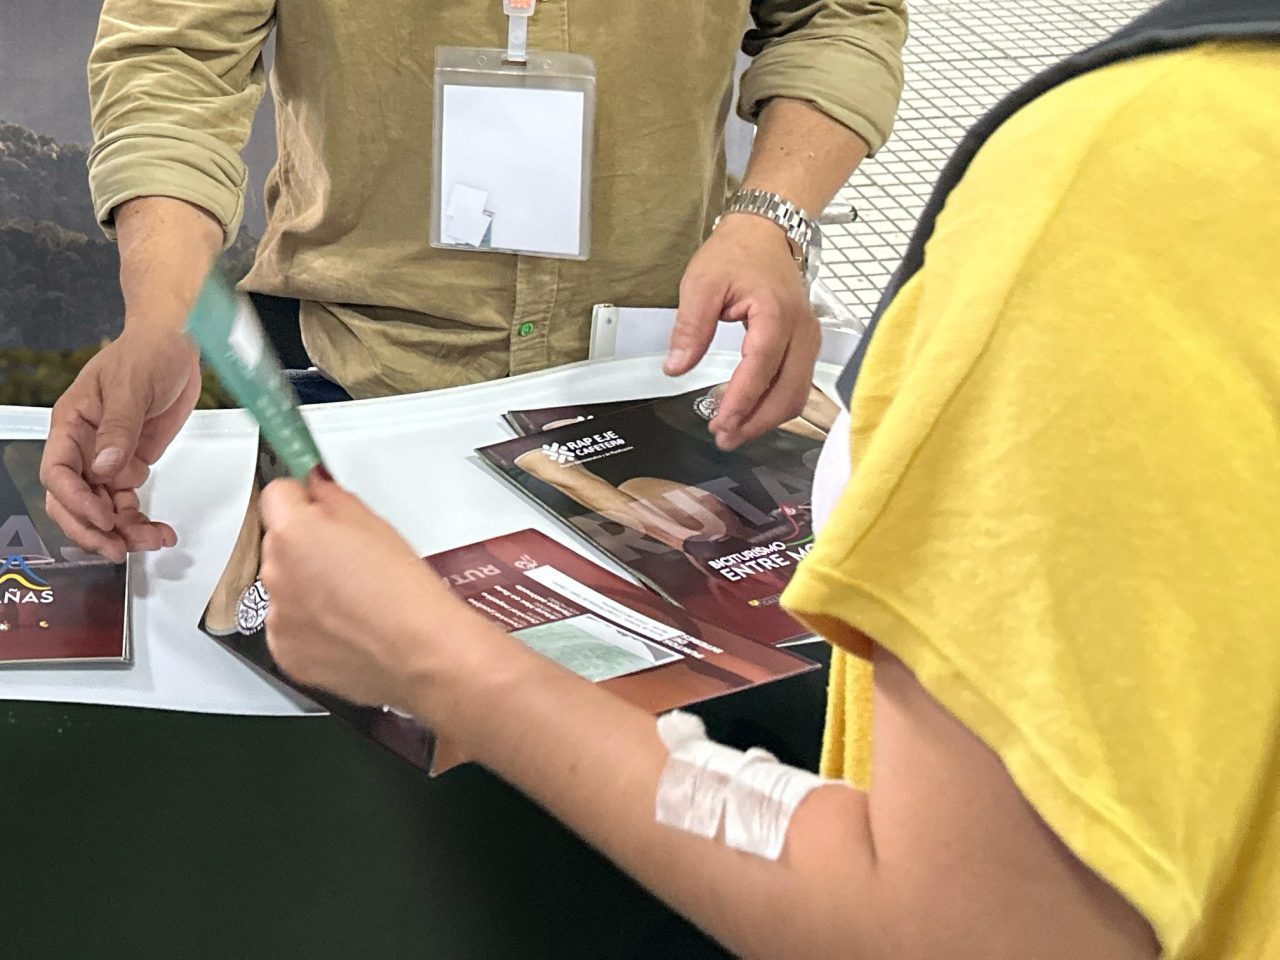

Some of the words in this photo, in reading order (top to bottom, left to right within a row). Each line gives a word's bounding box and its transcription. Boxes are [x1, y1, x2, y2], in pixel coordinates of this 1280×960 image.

[566, 437, 593, 450] RAP
[593, 430, 619, 444] EJE
[575, 438, 626, 456] CAFETERO
[708, 541, 787, 570] BICITURISMO
[720, 553, 791, 582] ENTRE
